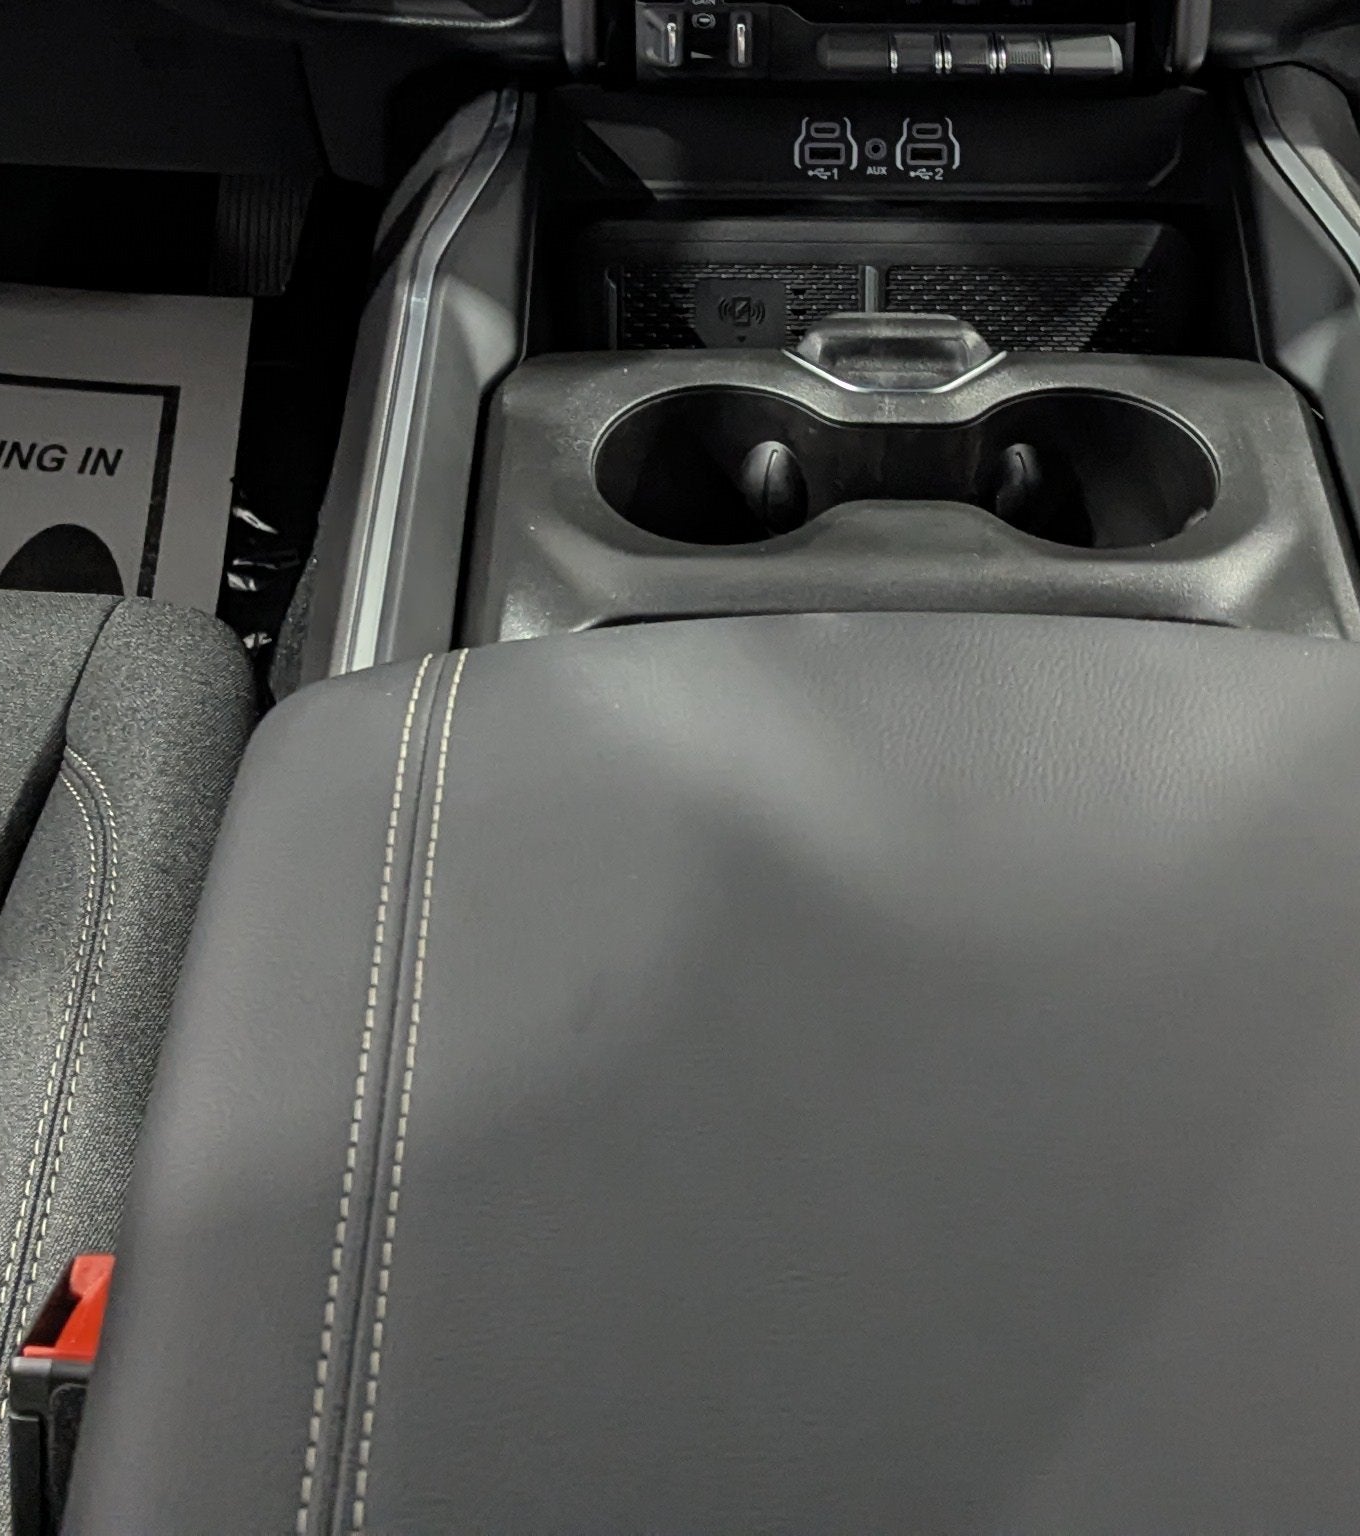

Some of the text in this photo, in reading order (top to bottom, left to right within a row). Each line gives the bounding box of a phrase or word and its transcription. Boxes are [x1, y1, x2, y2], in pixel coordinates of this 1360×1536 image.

[832, 168, 838, 180] 1
[866, 166, 888, 175] AUX
[934, 168, 944, 180] 2
[77, 446, 124, 477] IN
